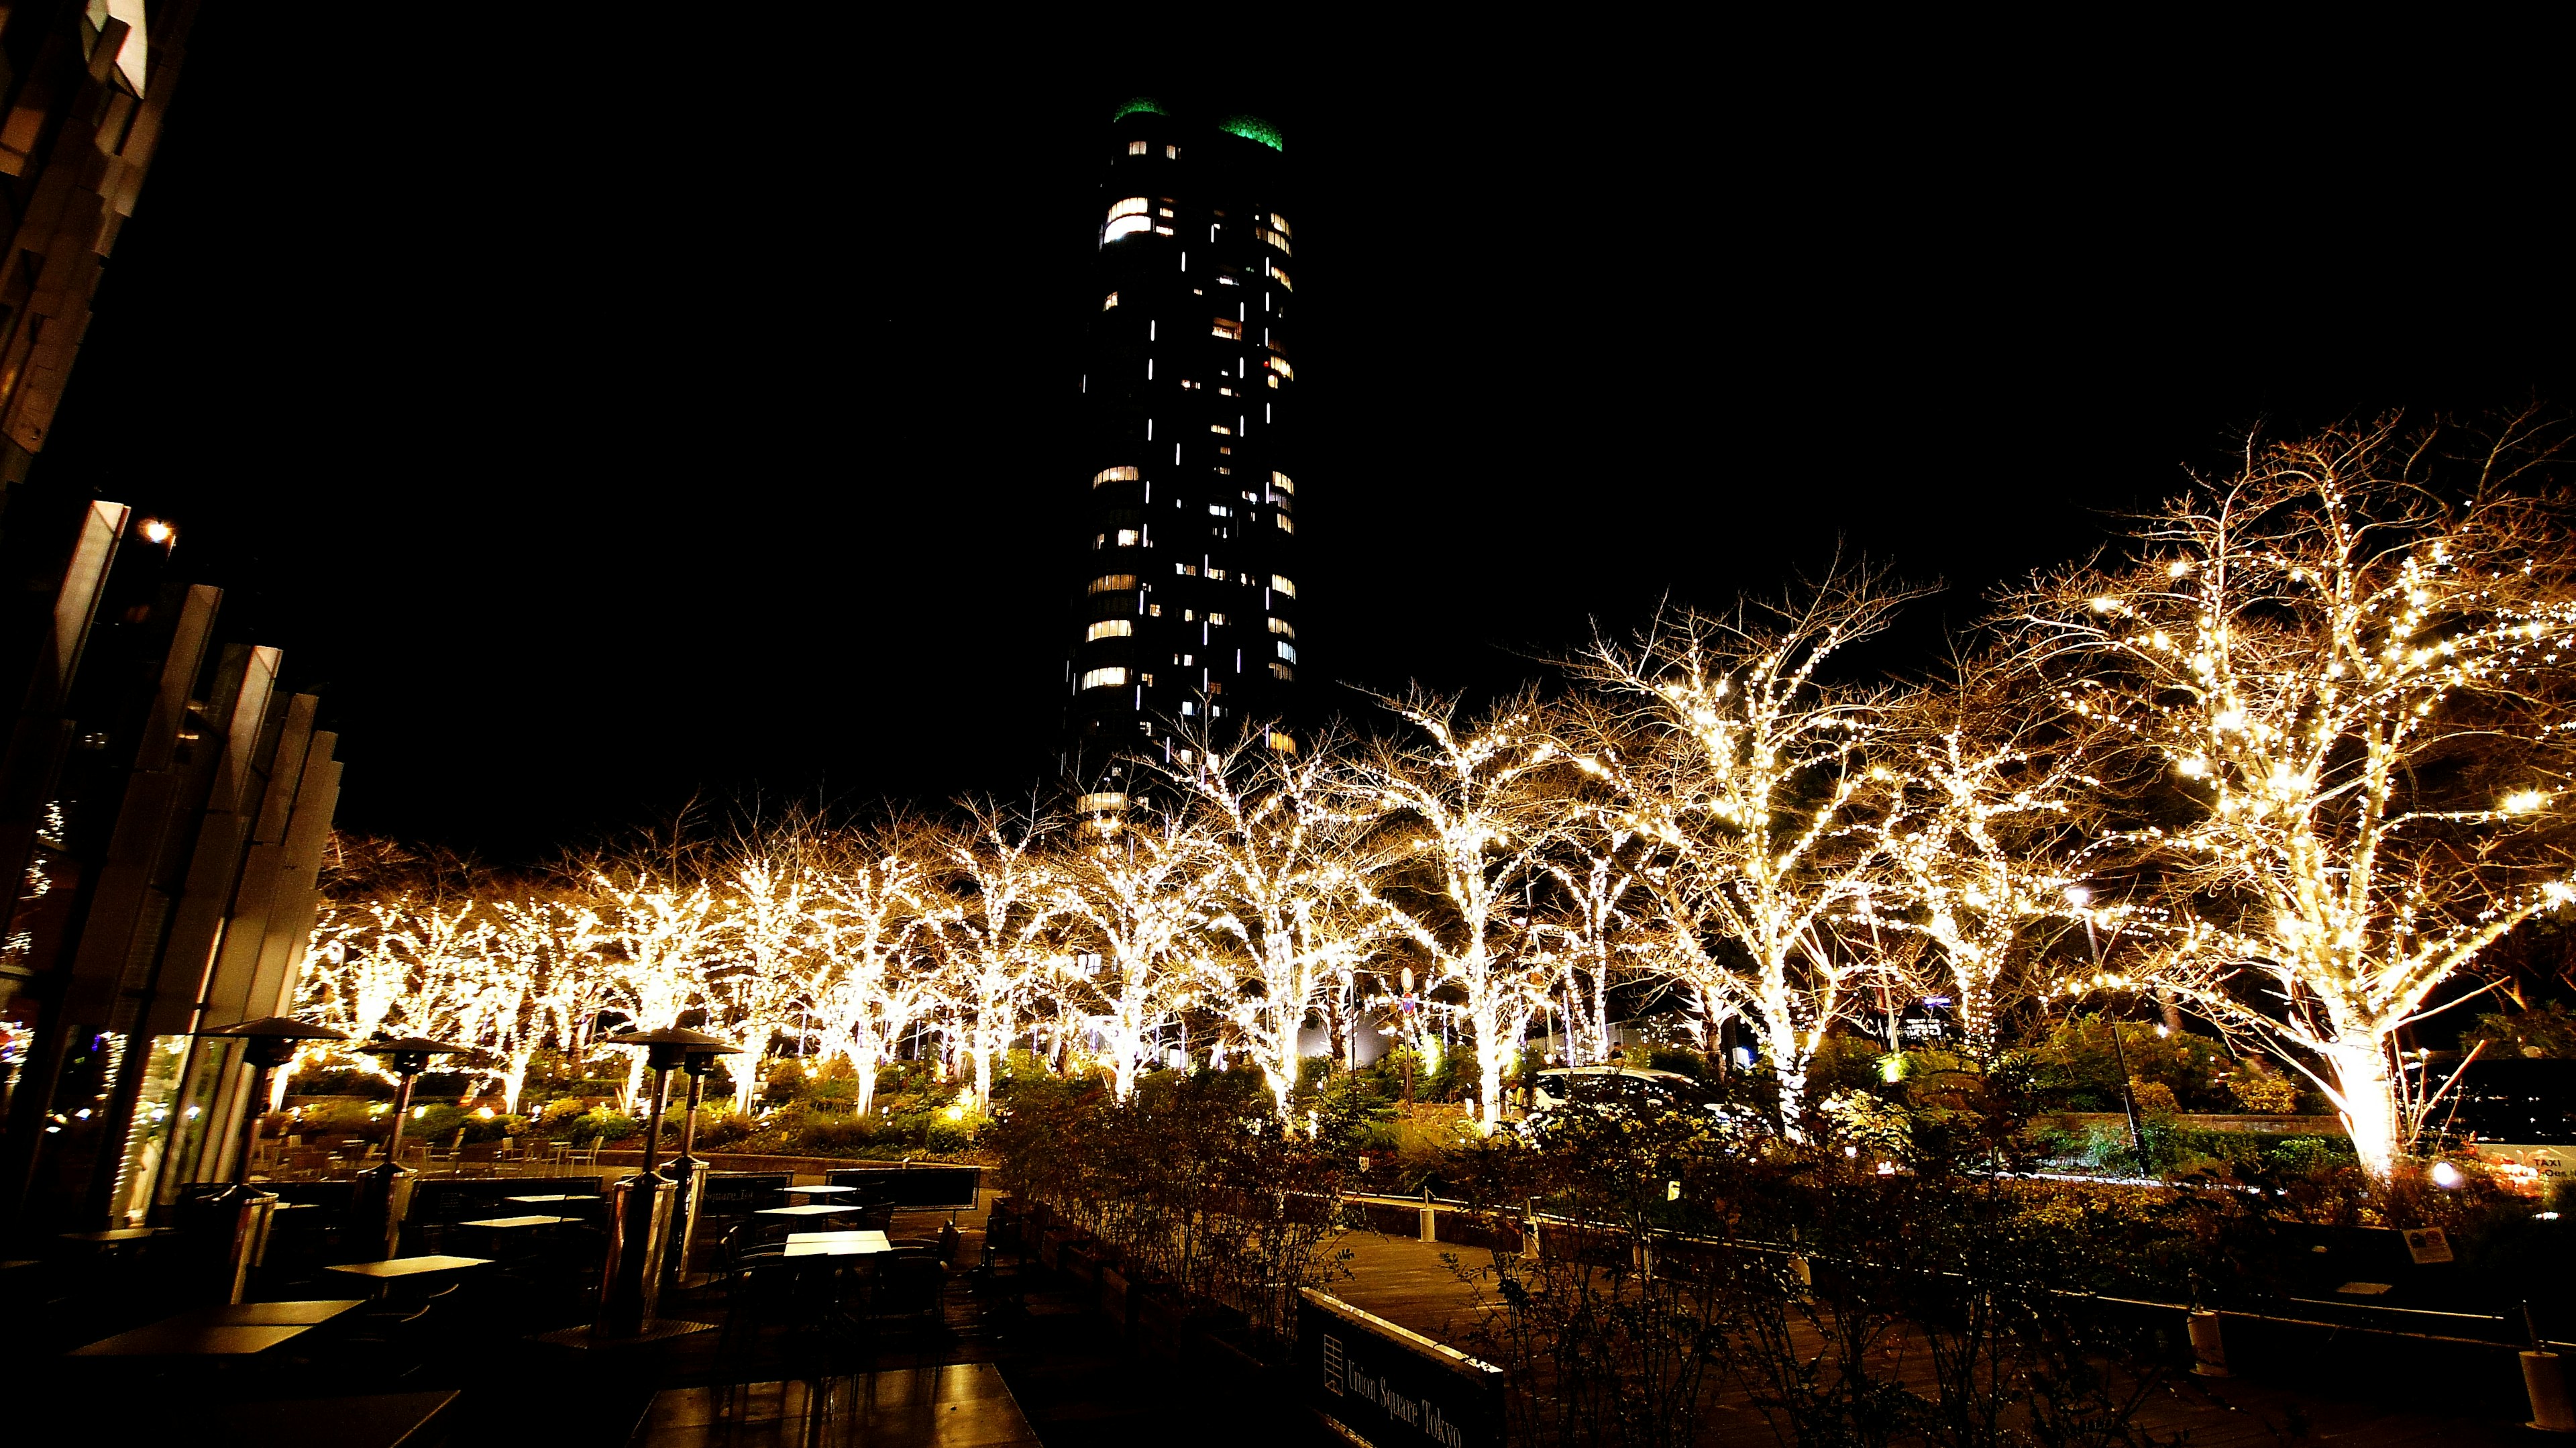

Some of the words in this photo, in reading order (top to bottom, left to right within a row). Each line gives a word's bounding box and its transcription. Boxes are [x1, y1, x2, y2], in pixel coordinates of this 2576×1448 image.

[2533, 1159, 2561, 1167] TAXI
[1347, 1358, 1377, 1403] Union
[1380, 1376, 1418, 1427] Square
[1421, 1398, 1461, 1448] Tokyo
